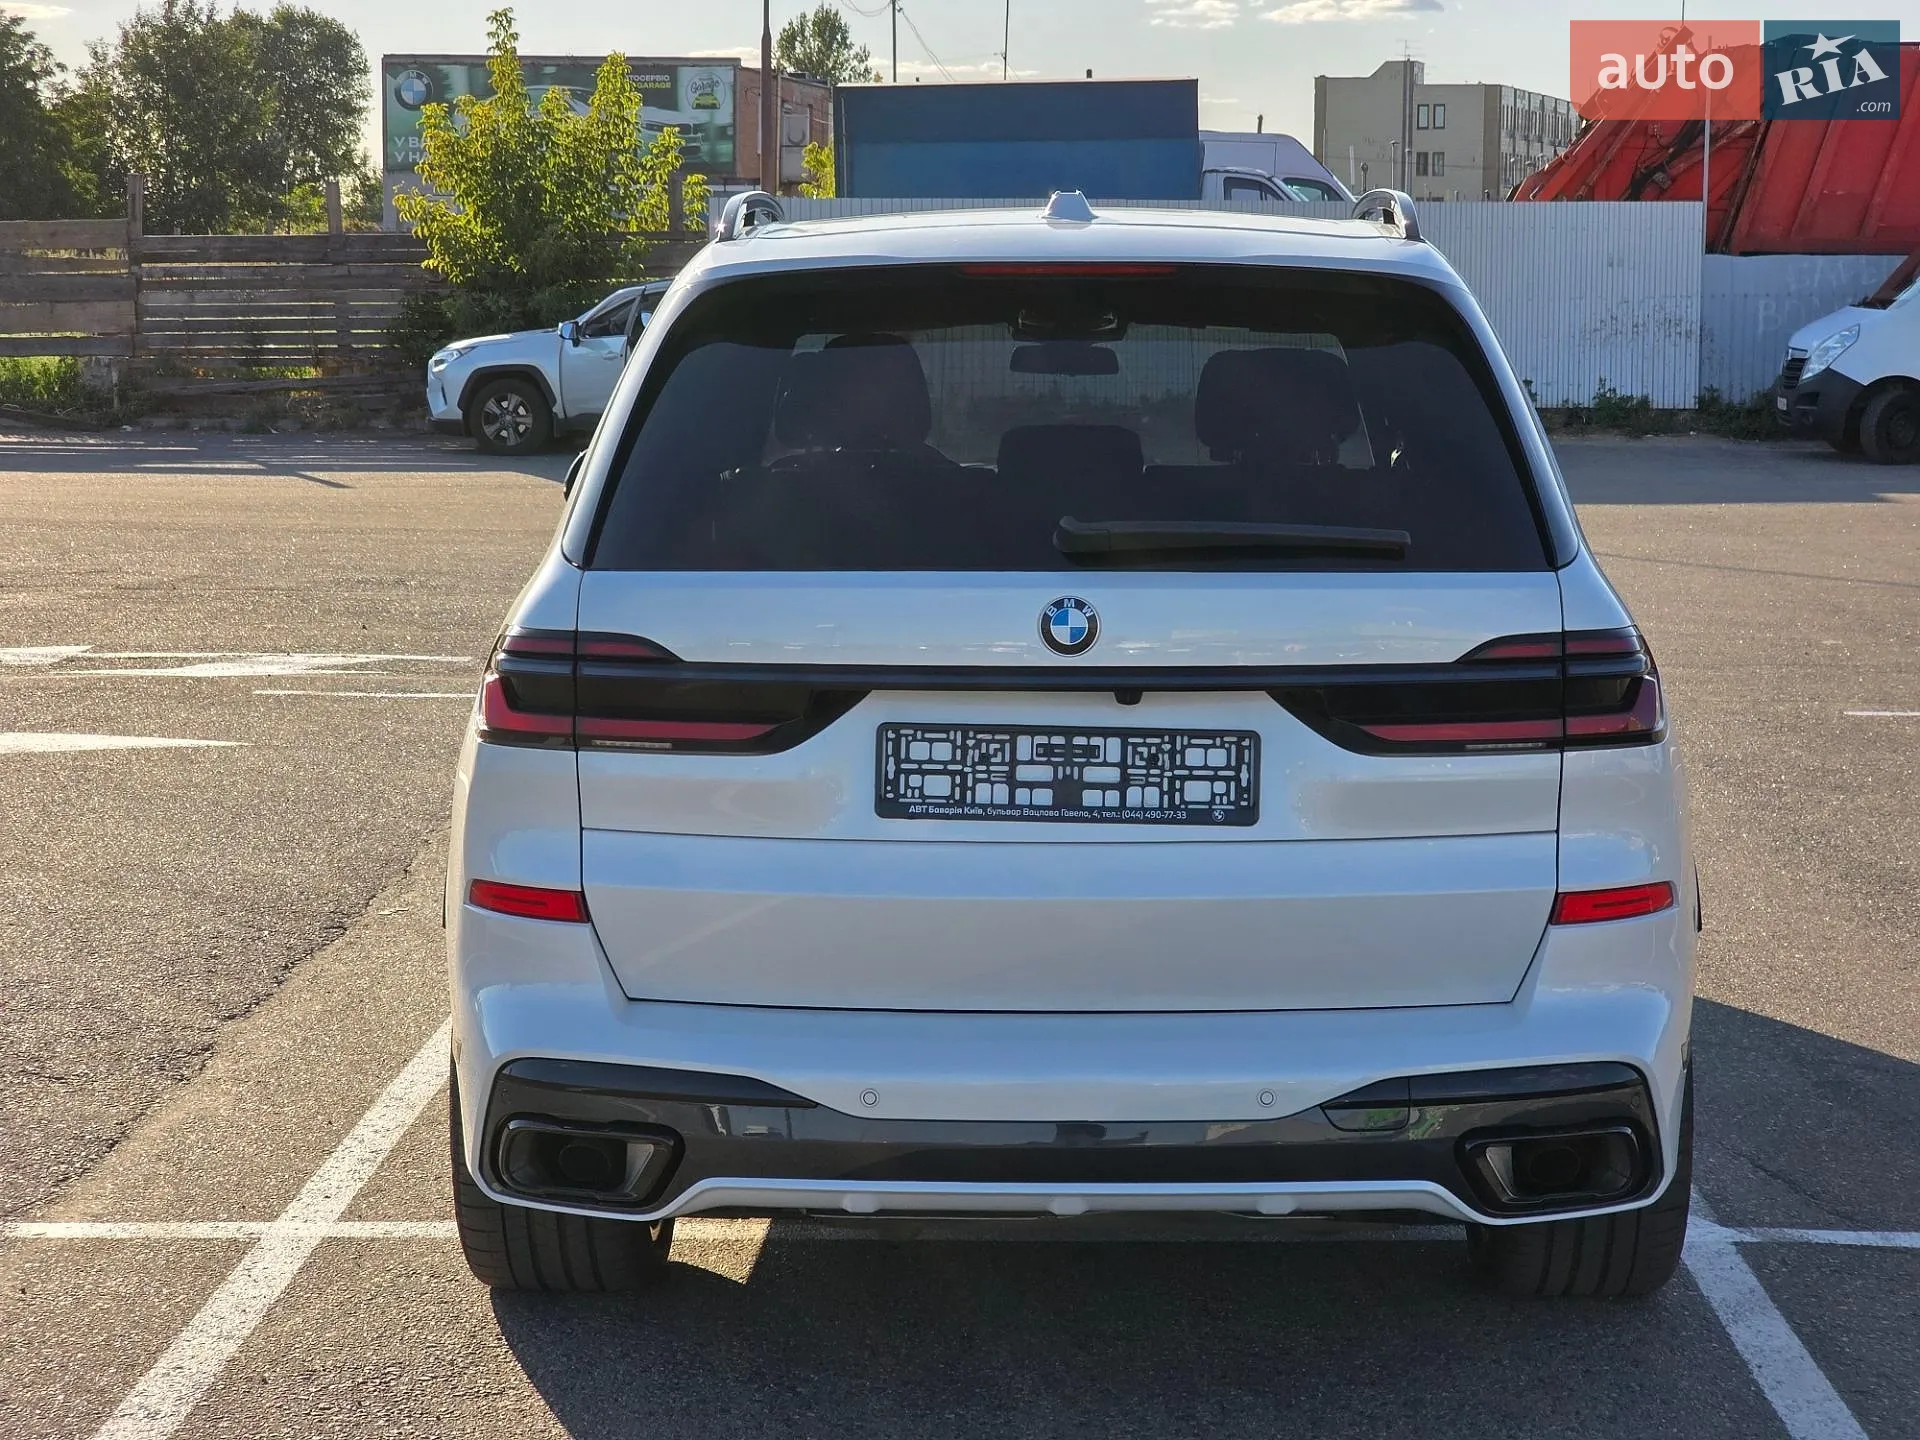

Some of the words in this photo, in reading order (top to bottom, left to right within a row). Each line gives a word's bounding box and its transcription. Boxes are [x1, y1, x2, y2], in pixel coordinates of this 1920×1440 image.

[1046, 598, 1094, 617] BMW
[908, 805, 928, 813] АВТ
[928, 805, 963, 815] Баворія
[964, 806, 986, 816] Київ,
[987, 806, 1021, 817] бульвар
[1022, 807, 1059, 817] Вацлава
[1091, 809, 1101, 819] 4,
[1121, 809, 1144, 820] (044)
[1144, 810, 1187, 819] 490-77-33
